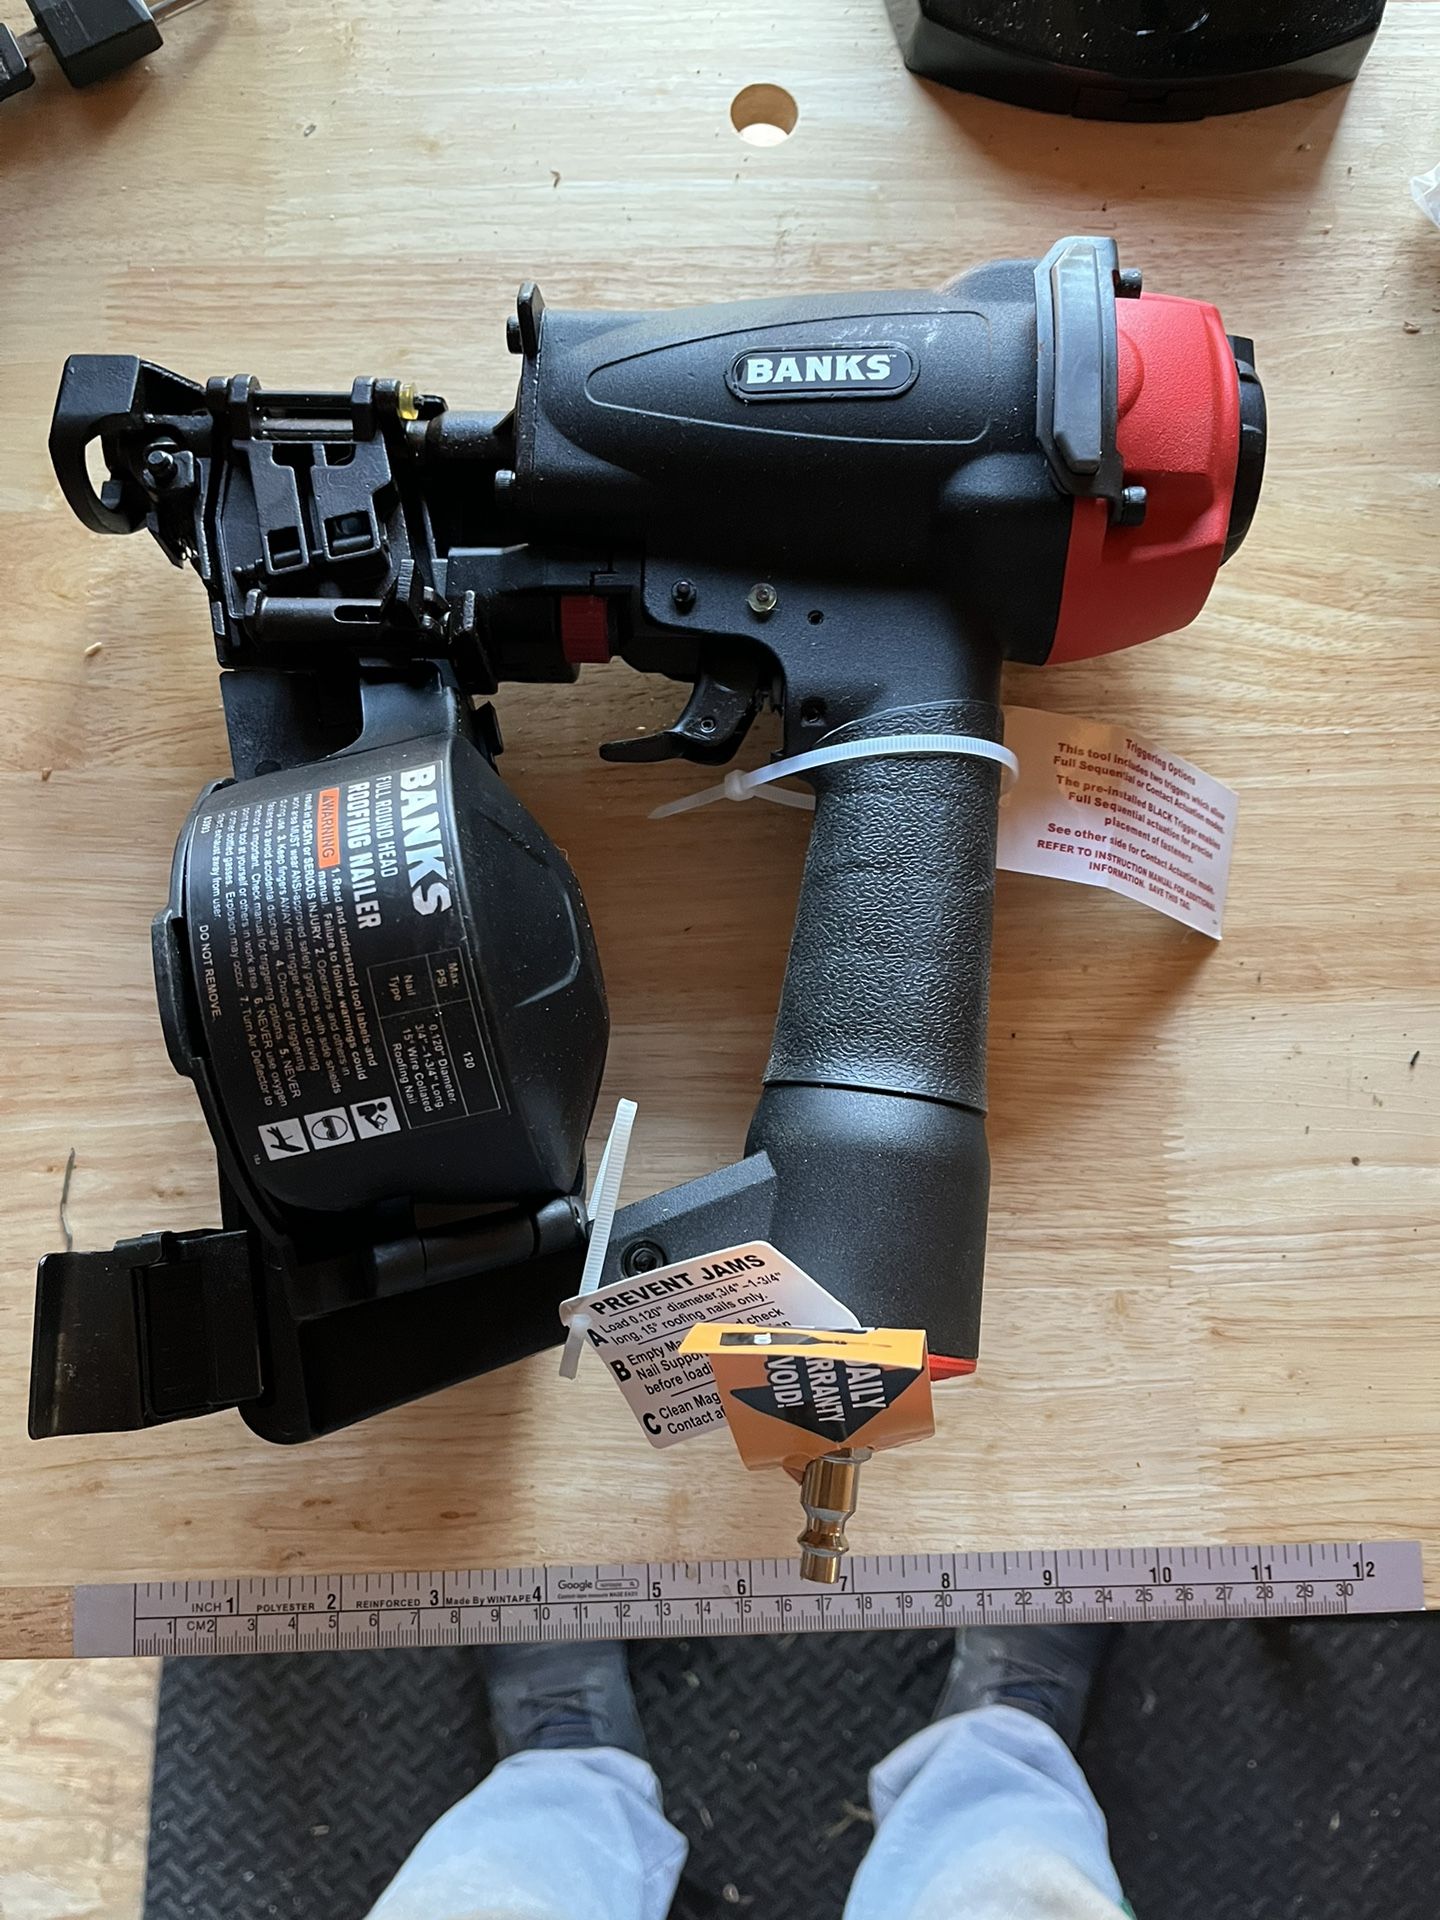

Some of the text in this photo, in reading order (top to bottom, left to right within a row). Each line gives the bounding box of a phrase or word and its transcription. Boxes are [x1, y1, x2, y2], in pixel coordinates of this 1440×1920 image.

[747, 354, 890, 384] BANKS
[1058, 742, 1084, 757] This
[1088, 750, 1110, 763] tool
[1114, 754, 1149, 777] includes
[1126, 738, 1196, 786] Triggering Options
[1053, 755, 1075, 768] Full
[1079, 761, 1136, 785] Sequential
[1136, 779, 1145, 788] or
[1146, 782, 1173, 805] Contact
[1056, 774, 1198, 837] The pre-installed BLACK Trigger
[1068, 791, 1091, 805] Full
[1094, 797, 1146, 826] Sequential
[1146, 817, 1180, 841] actuation
[303, 819, 312, 846] DEATH
[322, 801, 334, 858] WARNING
[375, 776, 398, 877] FULL ROUND HEAD
[400, 765, 452, 916] BANKS
[1104, 816, 1151, 843] placement
[1152, 835, 1160, 845] of
[276, 844, 286, 864] Keep
[304, 847, 311, 856] or
[347, 782, 381, 929] ROOFING NAILER
[1047, 822, 1071, 836] See
[1074, 827, 1107, 844] other
[1110, 836, 1127, 850] side
[1128, 843, 1140, 855] for
[1140, 850, 1167, 870] Contact
[304, 857, 316, 900] SERIOUS
[1037, 839, 1074, 854] REFER
[1078, 846, 1093, 857] TO
[1095, 850, 1148, 879] INSTRUCTION
[1149, 870, 1173, 890] MANUAL
[276, 866, 288, 895] fingers
[332, 879, 342, 903] Read
[280, 897, 292, 924] AWAY
[335, 906, 347, 924] and
[199, 925, 210, 941] DO
[285, 929, 295, 950] from
[322, 913, 336, 949] Failure
[201, 943, 213, 965] NOT
[287, 953, 301, 984] trigger
[298, 941, 312, 969] safety
[330, 951, 338, 961] to
[339, 927, 358, 987] understand
[303, 973, 319, 1012] goggles
[317, 960, 335, 1009] Operators
[332, 964, 346, 996] follow
[389, 976, 401, 1001] Type
[404, 975, 416, 996] Nail
[436, 969, 446, 987] PSI
[294, 989, 307, 1016] when
[350, 990, 364, 1010] tool
[448, 962, 475, 1068] Max. 120
[301, 1019, 312, 1035] not
[314, 1015, 327, 1035] with
[328, 1013, 340, 1031] and
[339, 1000, 357, 1048] warnings
[356, 1013, 371, 1044] labels
[304, 1037, 320, 1071] driving
[333, 1034, 349, 1064] others
[365, 1046, 378, 1066] and
[326, 1061, 342, 1094] shields
[352, 1051, 367, 1080] could
[392, 1043, 417, 1104] Roofing Nail
[407, 1047, 419, 1070] Wire
[414, 1073, 432, 1112] Collated
[589, 1254, 766, 1315] PREVENT JAMS
[600, 1316, 631, 1334] Load
[611, 1331, 643, 1346] long,
[662, 1311, 705, 1329] roofing
[707, 1299, 737, 1315] nails
[739, 1291, 768, 1308] only.
[587, 1328, 609, 1347] A
[627, 1345, 665, 1366] Empty
[746, 1308, 785, 1325] check
[610, 1359, 631, 1382] B
[636, 1363, 660, 1380] Nail
[644, 1376, 683, 1396] before
[806, 1358, 845, 1422] RRANTY
[642, 1413, 661, 1435] C
[659, 1400, 693, 1419] Clean
[667, 1411, 714, 1434] Contact
[191, 1561, 1375, 1613] INCH 1 POLYESTER 2 REINFORCED 3 Made By WINTAPE 4 Google 5 6 7 8 9 10 11 12
[167, 1600, 751, 1634] 1 CM 2 3 4 5 6 7 8 9 10 11 12 13 14 15
